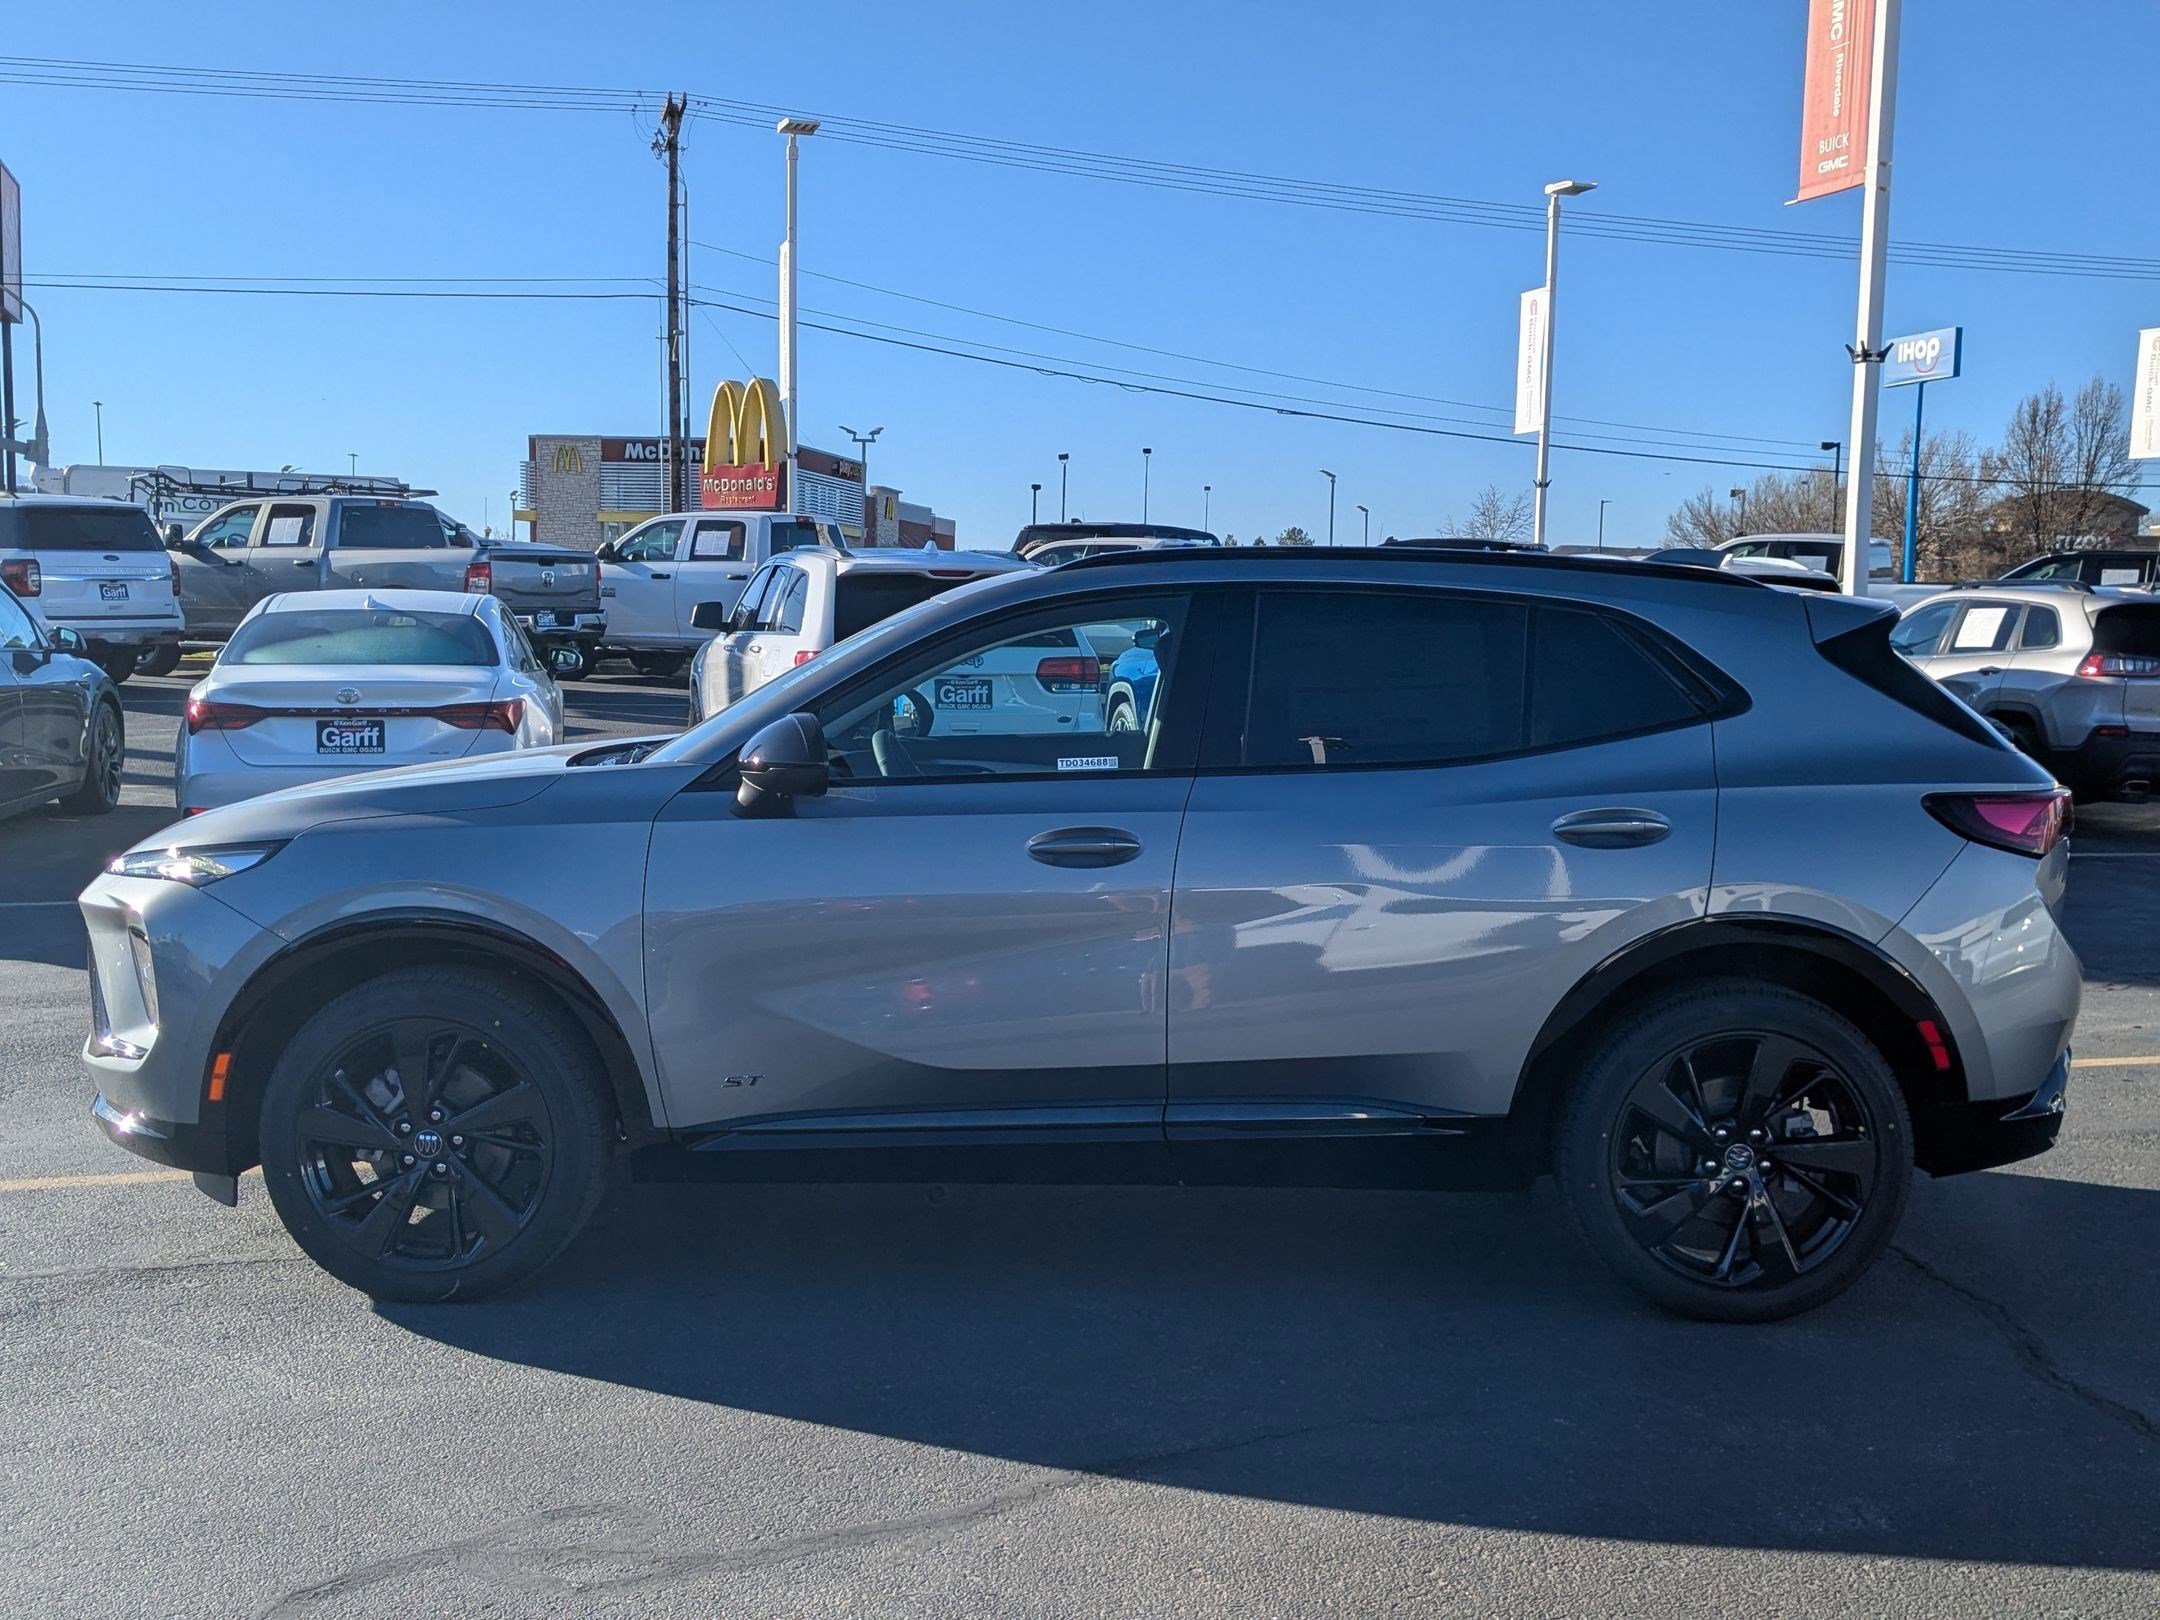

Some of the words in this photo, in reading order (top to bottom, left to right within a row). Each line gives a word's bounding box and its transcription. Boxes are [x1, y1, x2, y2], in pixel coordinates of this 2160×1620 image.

[1832, 52, 1845, 118] Riverdale
[1819, 132, 1850, 154] BUICK
[1818, 155, 1849, 174] GMC
[703, 476, 774, 493] McDonald's
[102, 587, 126, 597] Garff
[940, 685, 989, 703] Garff
[321, 727, 379, 747] Garff
[720, 1074, 767, 1088] ST
